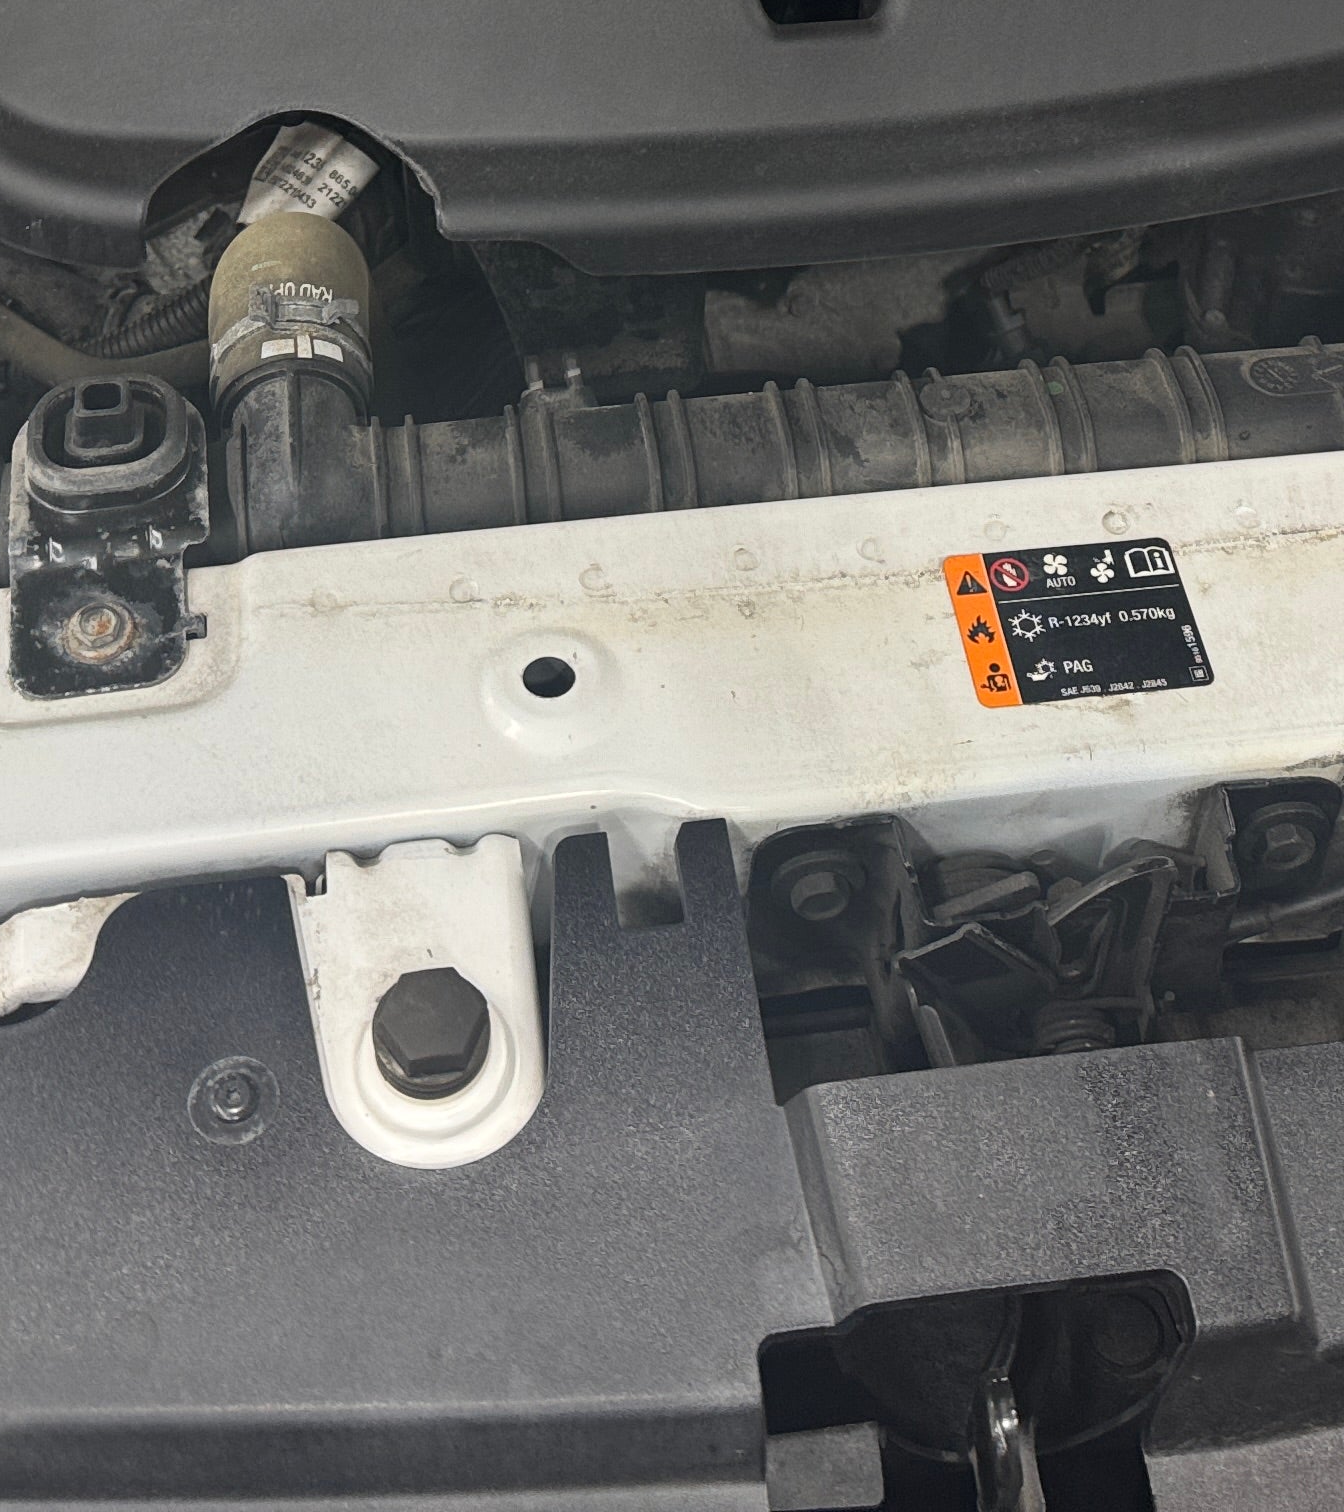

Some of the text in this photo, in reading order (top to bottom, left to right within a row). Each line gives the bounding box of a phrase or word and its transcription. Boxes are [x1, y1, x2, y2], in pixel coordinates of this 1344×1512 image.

[1046, 576, 1076, 589] AUTO
[1048, 607, 1176, 630] R-1234yf 0.570kg
[1062, 659, 1094, 674] PAG
[1060, 686, 1079, 697] SAE
